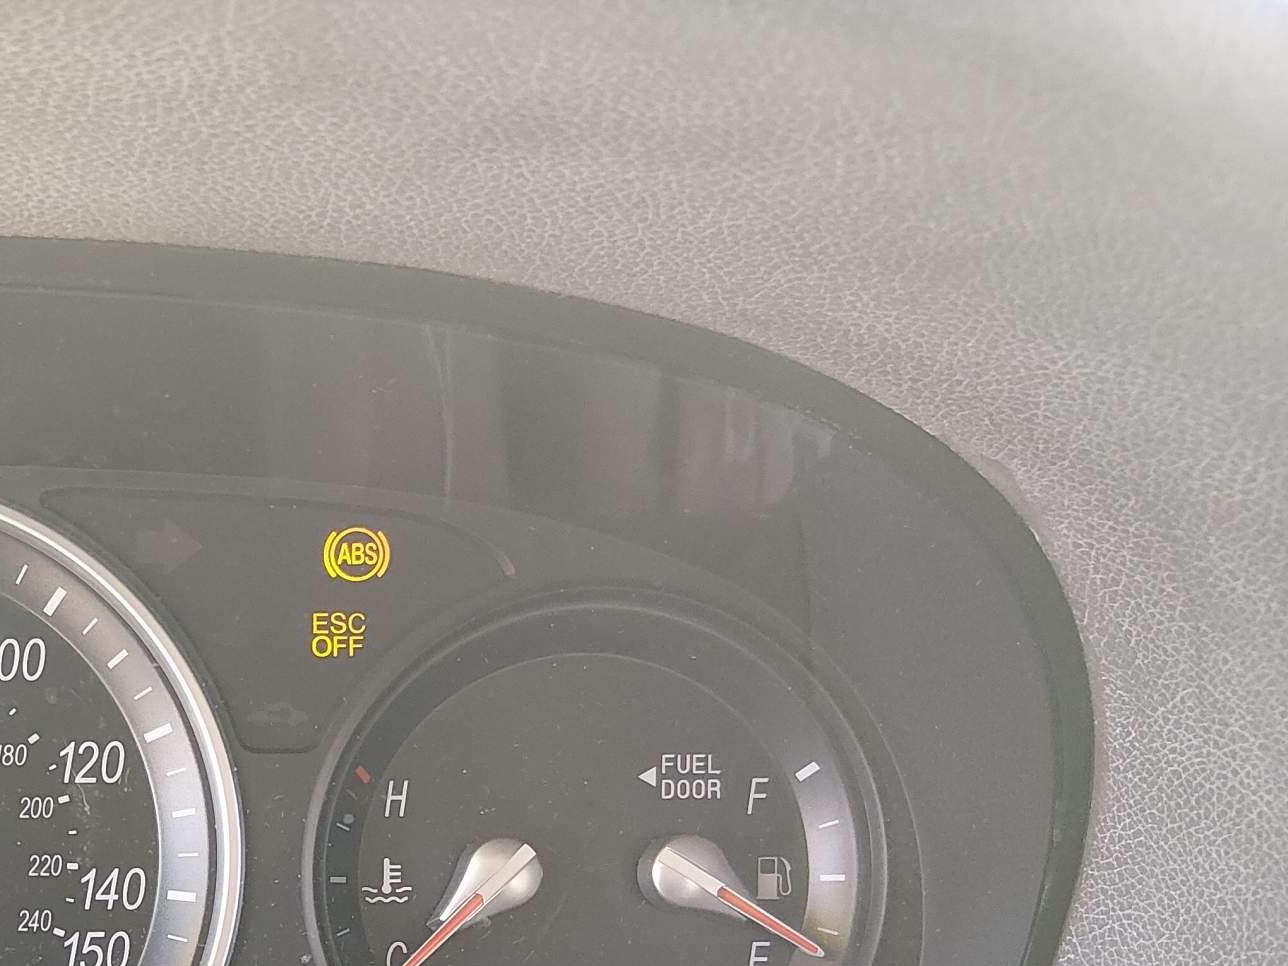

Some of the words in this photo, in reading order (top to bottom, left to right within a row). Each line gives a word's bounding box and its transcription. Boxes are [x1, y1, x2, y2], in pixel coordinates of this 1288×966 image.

[337, 541, 379, 566] ABS
[312, 612, 366, 634] ESC
[312, 635, 364, 657] OFF
[60, 741, 124, 783] 120
[661, 754, 721, 774] FUEL
[385, 781, 408, 816] H
[661, 780, 721, 799] DOOR
[748, 778, 768, 814] F
[20, 797, 53, 818] 200
[29, 855, 62, 876] 220
[79, 867, 145, 910] 140
[18, 910, 51, 931] 240
